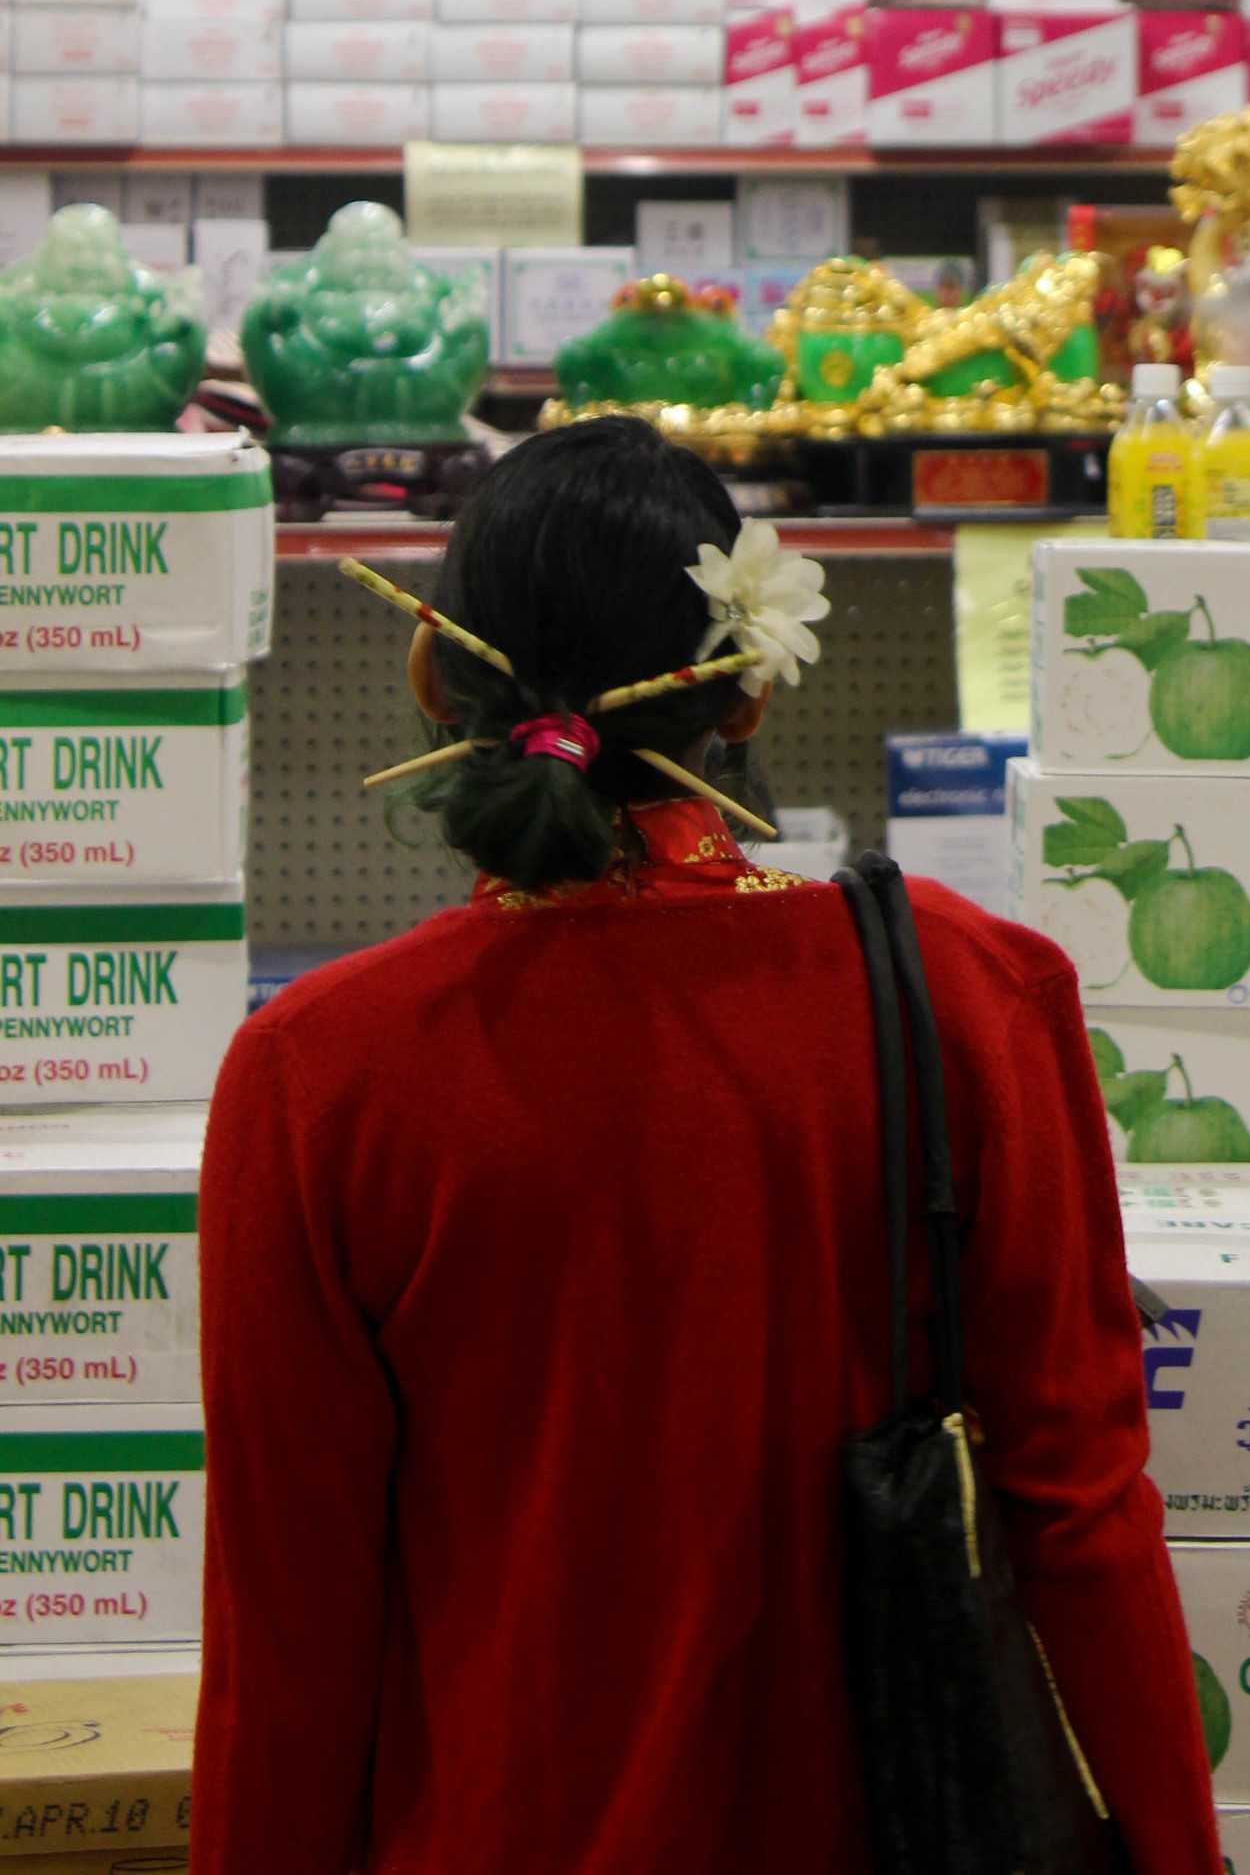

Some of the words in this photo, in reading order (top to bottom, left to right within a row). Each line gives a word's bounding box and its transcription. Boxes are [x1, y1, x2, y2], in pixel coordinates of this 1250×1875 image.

[58, 521, 168, 575] DRINK
[27, 625, 82, 653] (350
[91, 625, 141, 652] mL)
[54, 736, 163, 790] DRINK
[0, 800, 119, 822] NNYWORT
[20, 840, 74, 868] (350
[84, 840, 134, 867] mL)
[68, 951, 179, 1006] DRINK
[0, 1015, 135, 1039] ENNYWORT
[34, 1057, 90, 1086] (350
[98, 1057, 149, 1084] mL)
[0, 1244, 31, 1302] T
[52, 1242, 169, 1302] DRINK
[16, 1356, 75, 1385] (350
[84, 1355, 137, 1383] mL)
[62, 1480, 181, 1540] DRINK
[26, 1593, 85, 1623] (350
[94, 1591, 148, 1620] mL)
